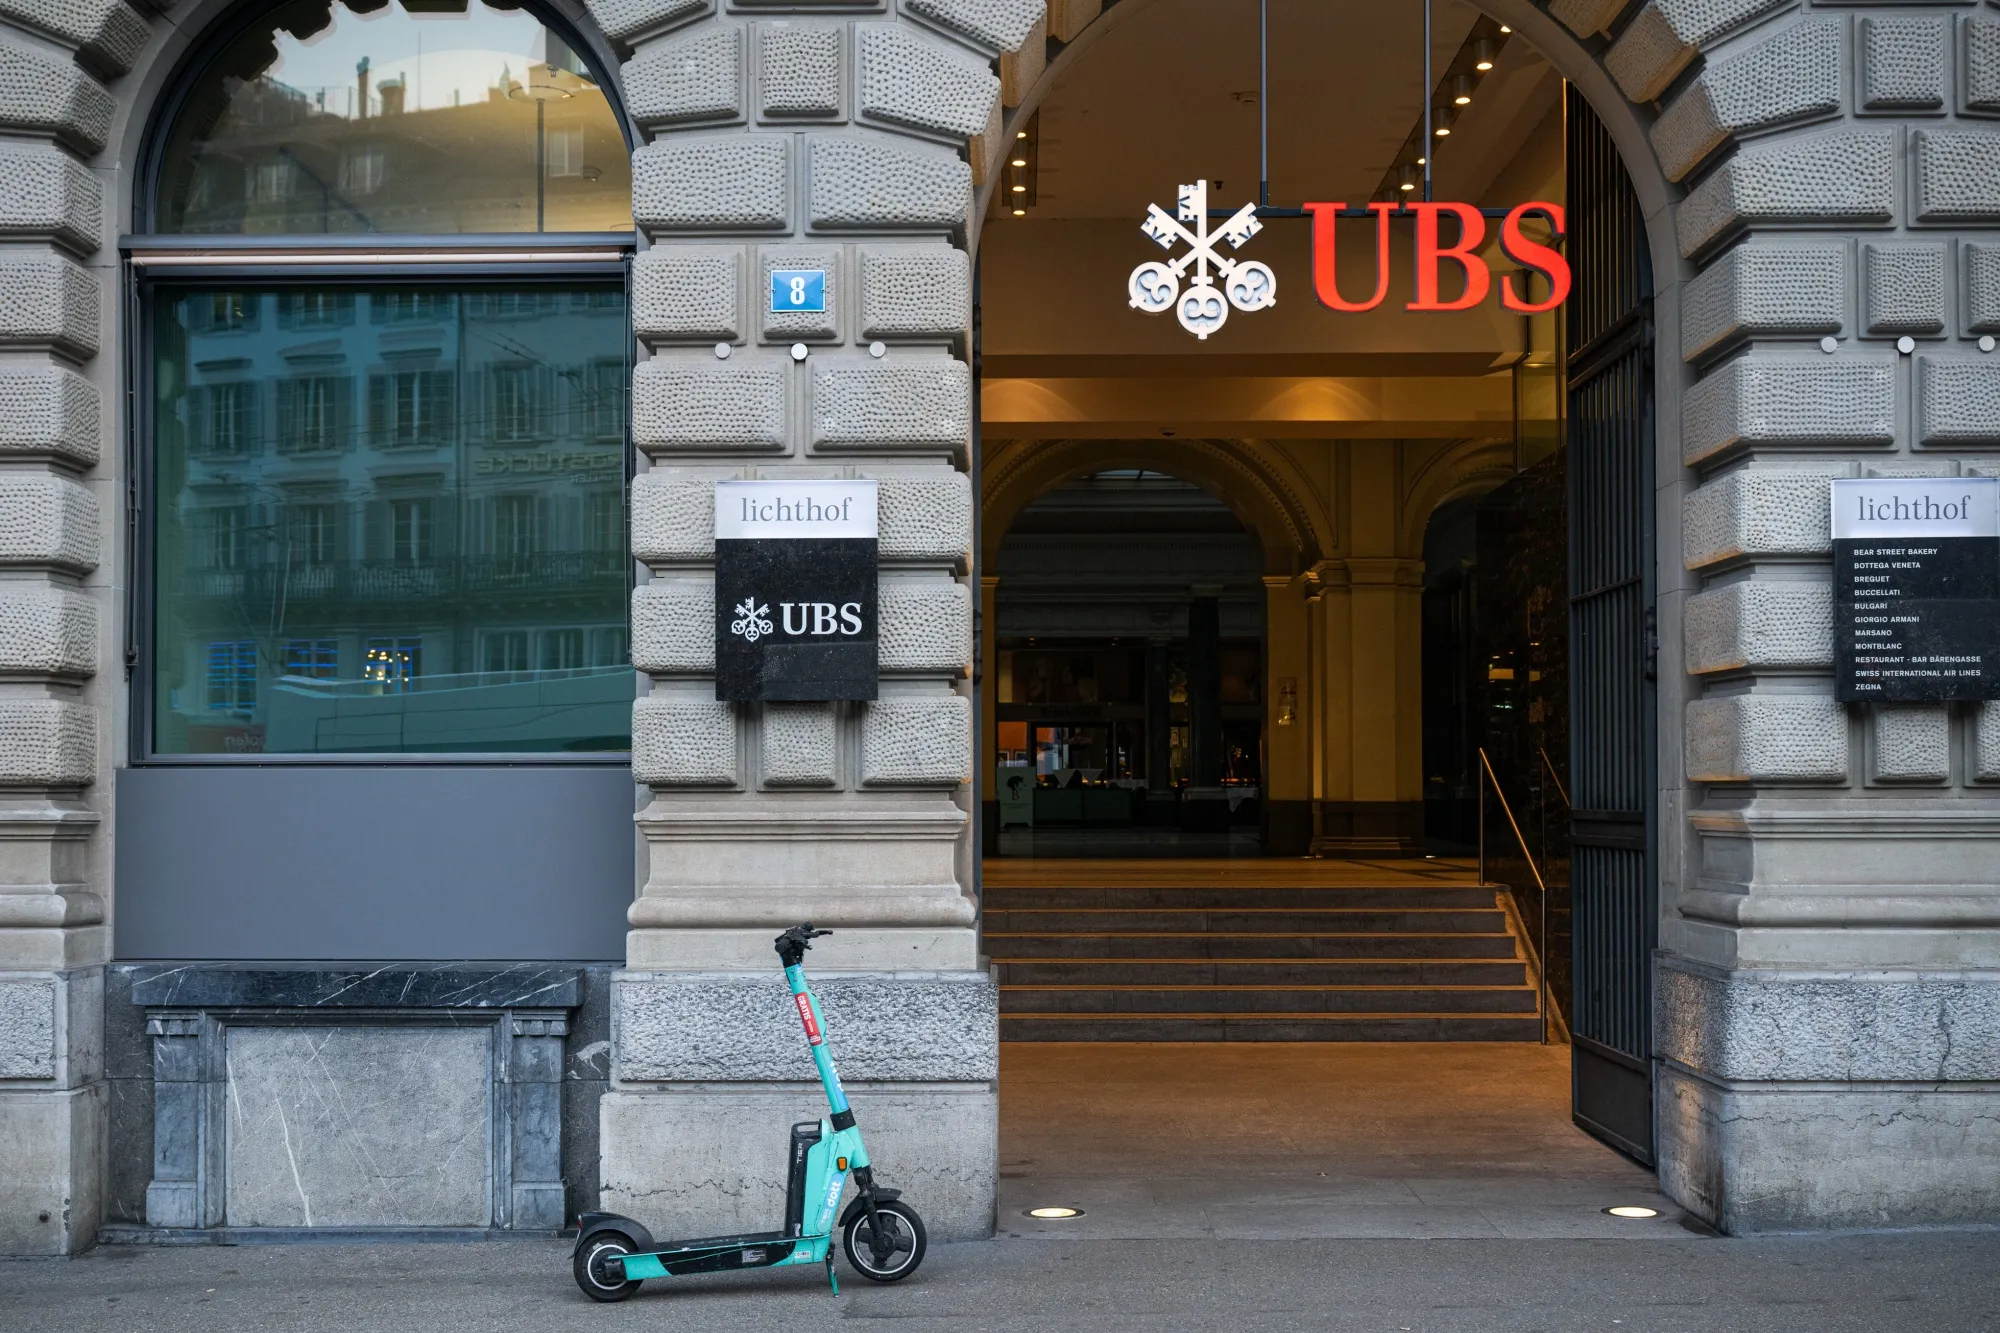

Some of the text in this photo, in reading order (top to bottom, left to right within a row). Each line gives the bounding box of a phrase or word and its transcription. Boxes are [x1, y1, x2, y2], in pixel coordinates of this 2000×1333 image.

[1302, 200, 1573, 314] UBS
[790, 276, 805, 305] 8
[741, 496, 853, 522] lichthof
[1858, 494, 1972, 521] lichthof
[1876, 548, 1906, 556] STREET
[779, 602, 862, 635] UBS
[1929, 655, 1981, 663] BÄRENGASSE
[797, 995, 811, 1020] GRATIS
[827, 1181, 841, 1207] dott
